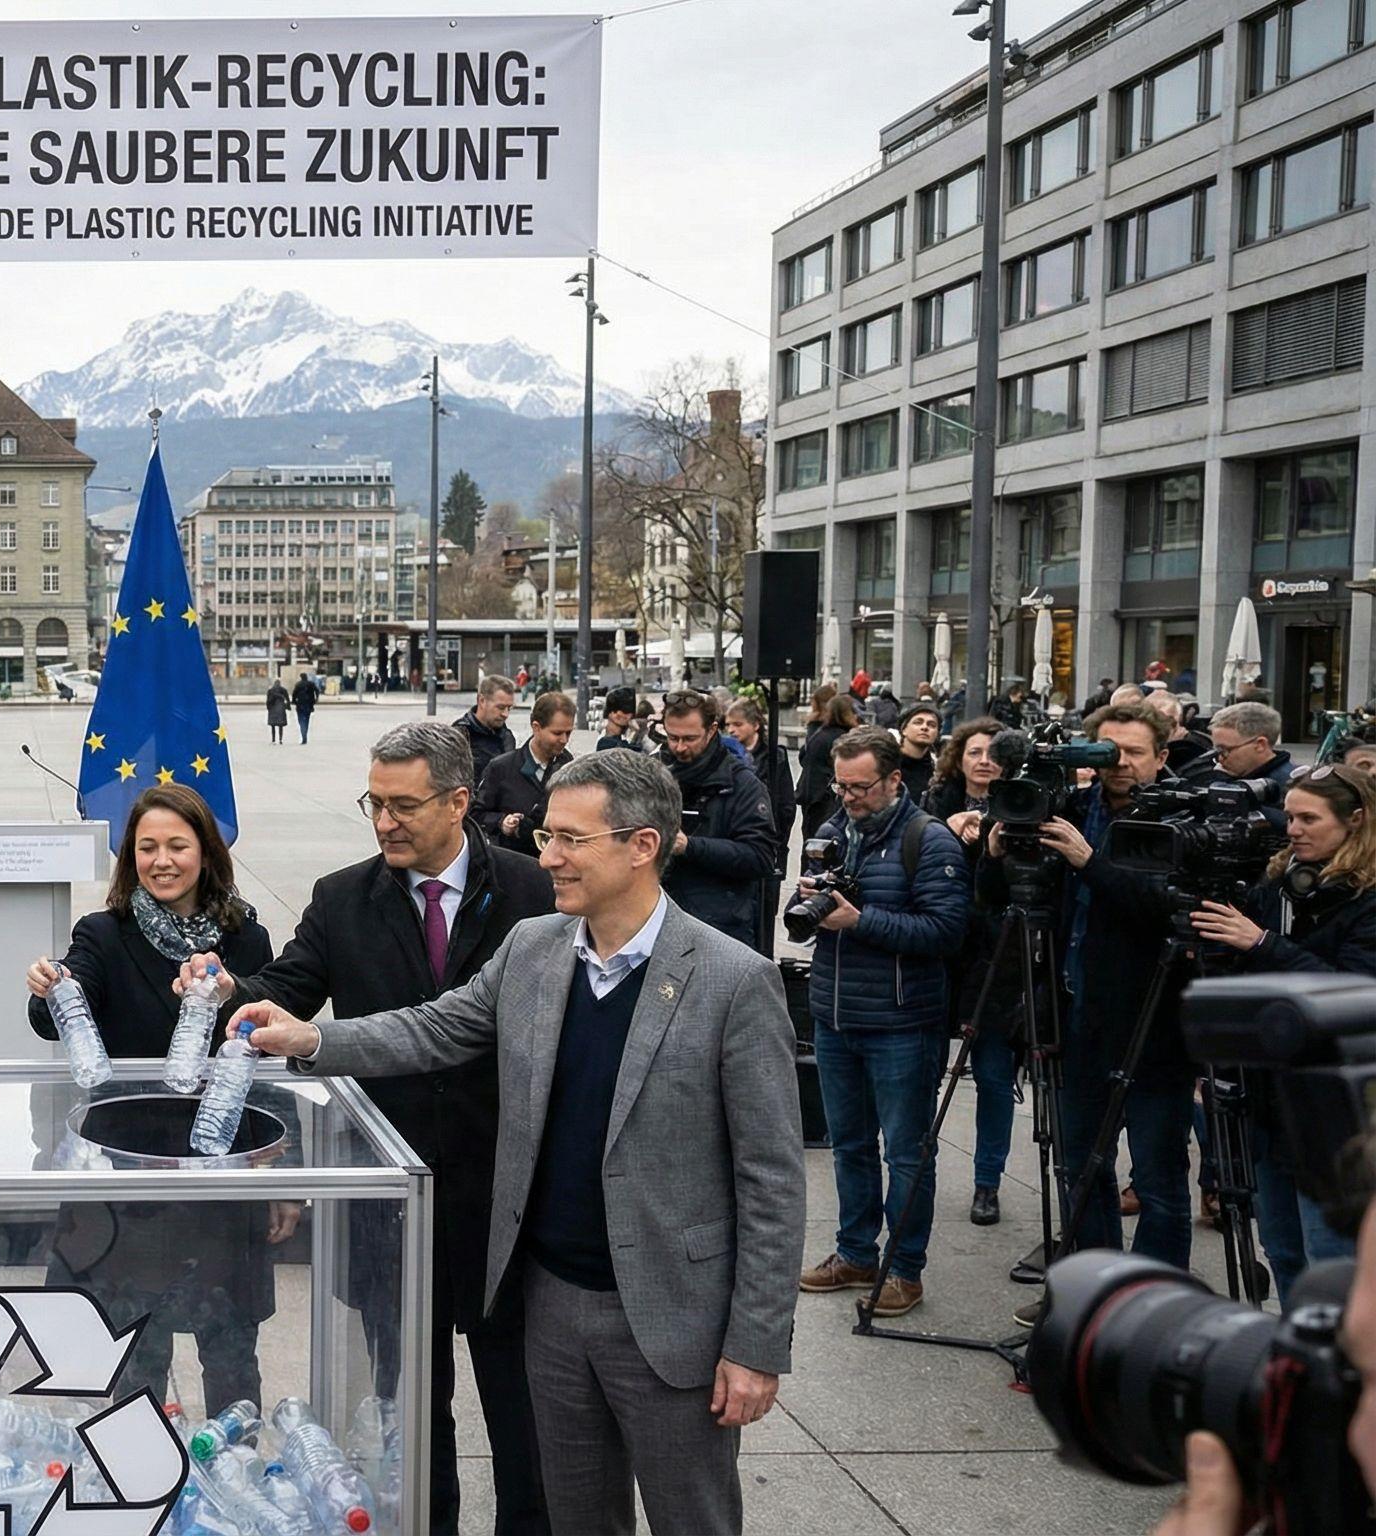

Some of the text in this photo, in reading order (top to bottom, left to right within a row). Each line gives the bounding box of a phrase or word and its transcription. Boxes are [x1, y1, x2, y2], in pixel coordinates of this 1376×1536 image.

[29, 129, 286, 186] SAUBERE
[305, 126, 560, 183] ZUKUNFT
[45, 206, 175, 240] PLASTIC
[186, 205, 362, 239] RECYCLING
[373, 204, 534, 237] INITIATIVE
